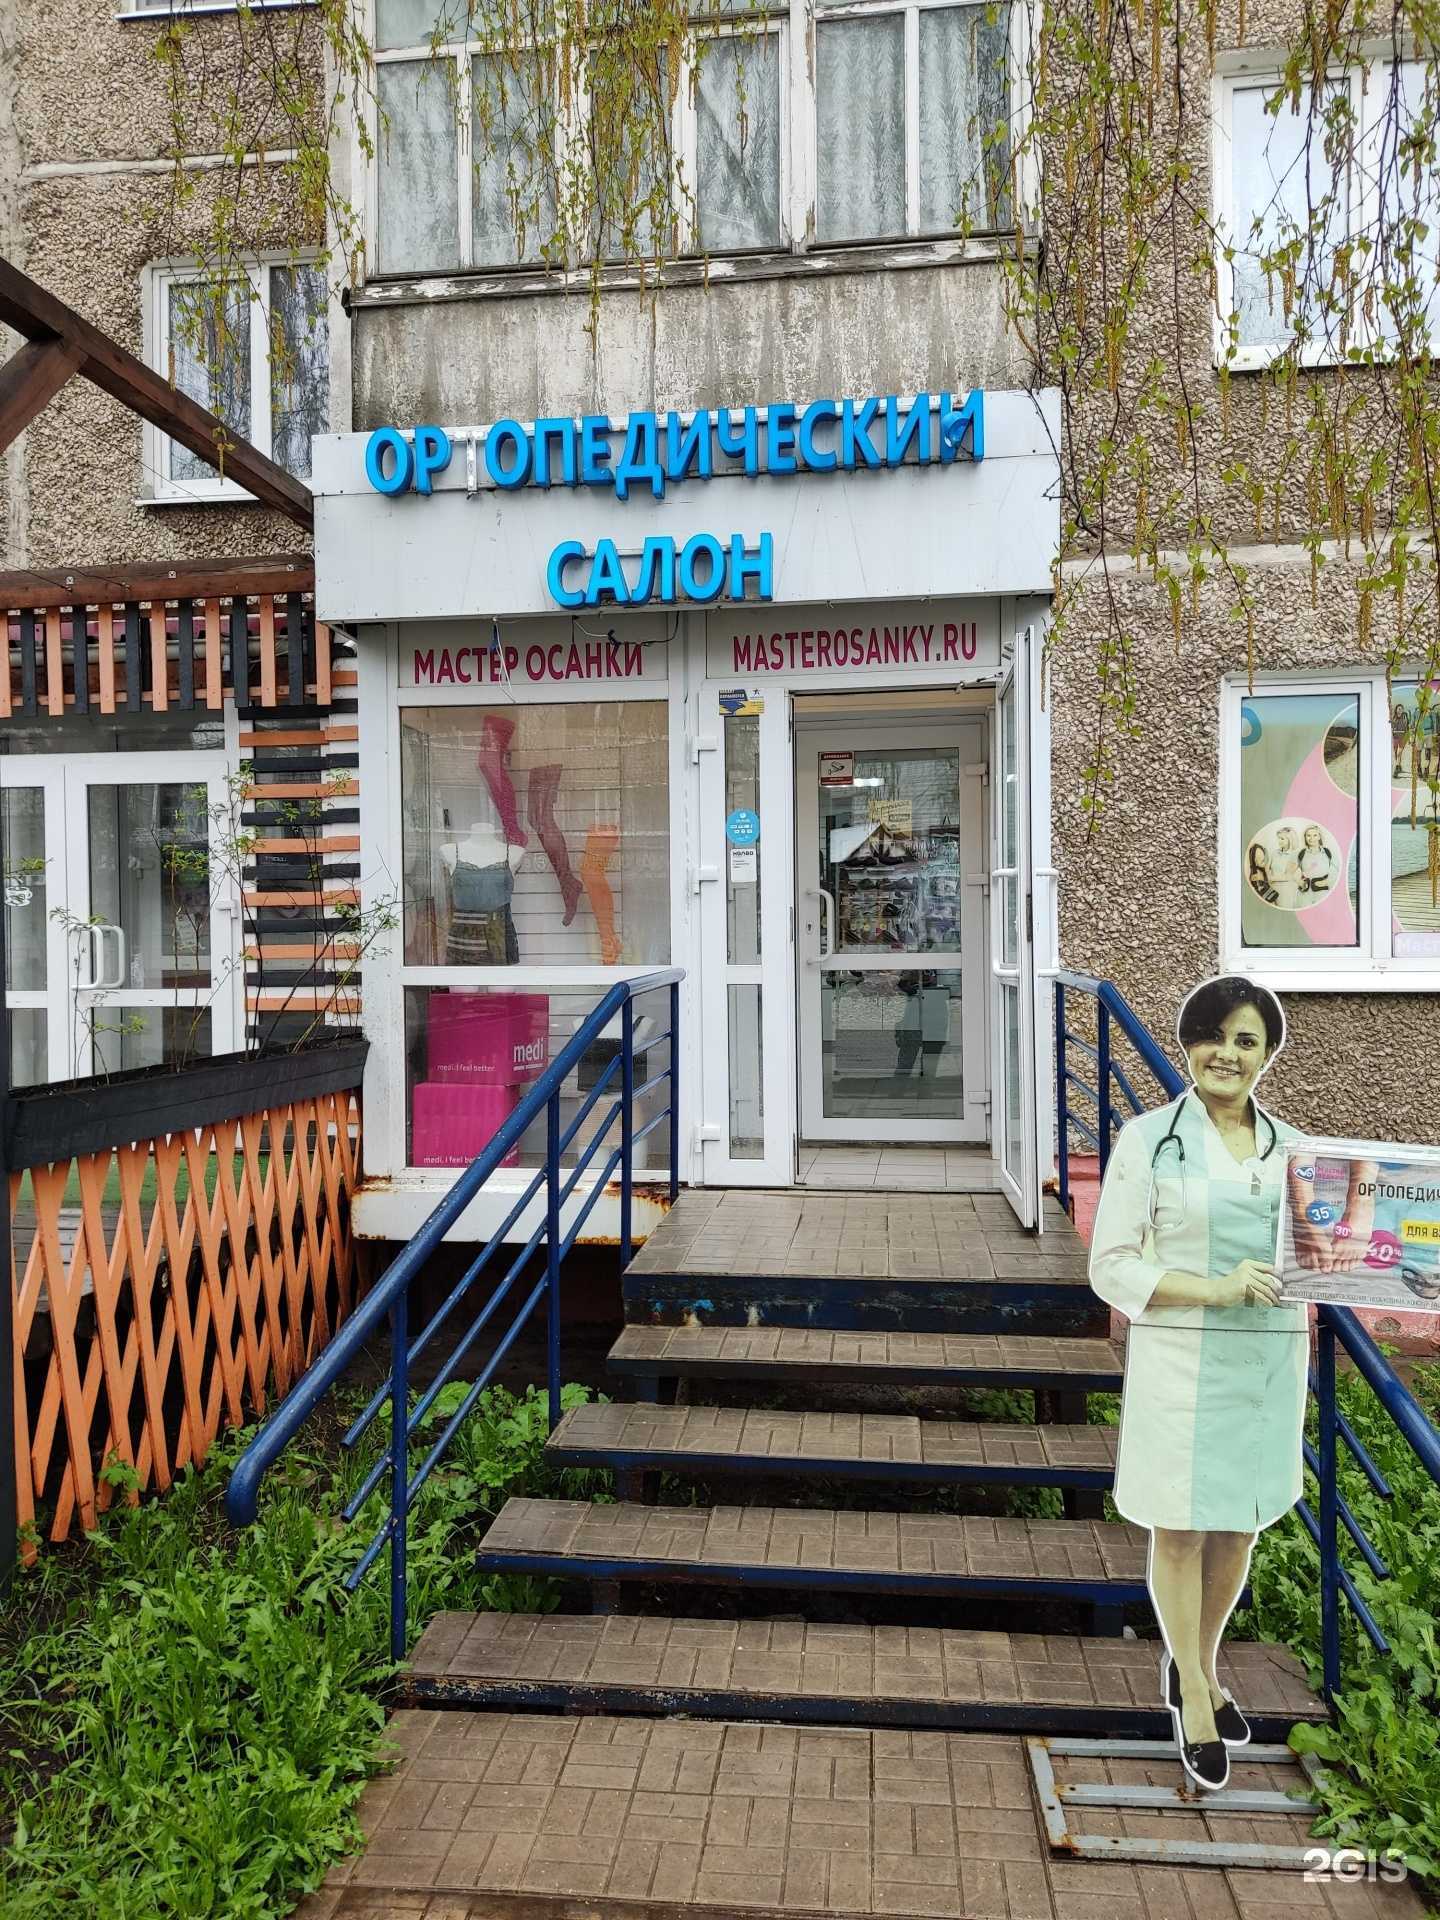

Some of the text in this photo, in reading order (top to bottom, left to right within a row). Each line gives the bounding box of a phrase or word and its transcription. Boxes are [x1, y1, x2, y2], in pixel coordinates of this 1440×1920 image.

[547, 532, 773, 609] САЛОН
[414, 642, 643, 684] МАСТЕР ОСАНКИ
[733, 622, 977, 672] MASTEROSANKY.RU
[513, 1037, 544, 1063] medi
[449, 1155, 463, 1164] feel
[1406, 1225, 1428, 1238] ДЛЯ
